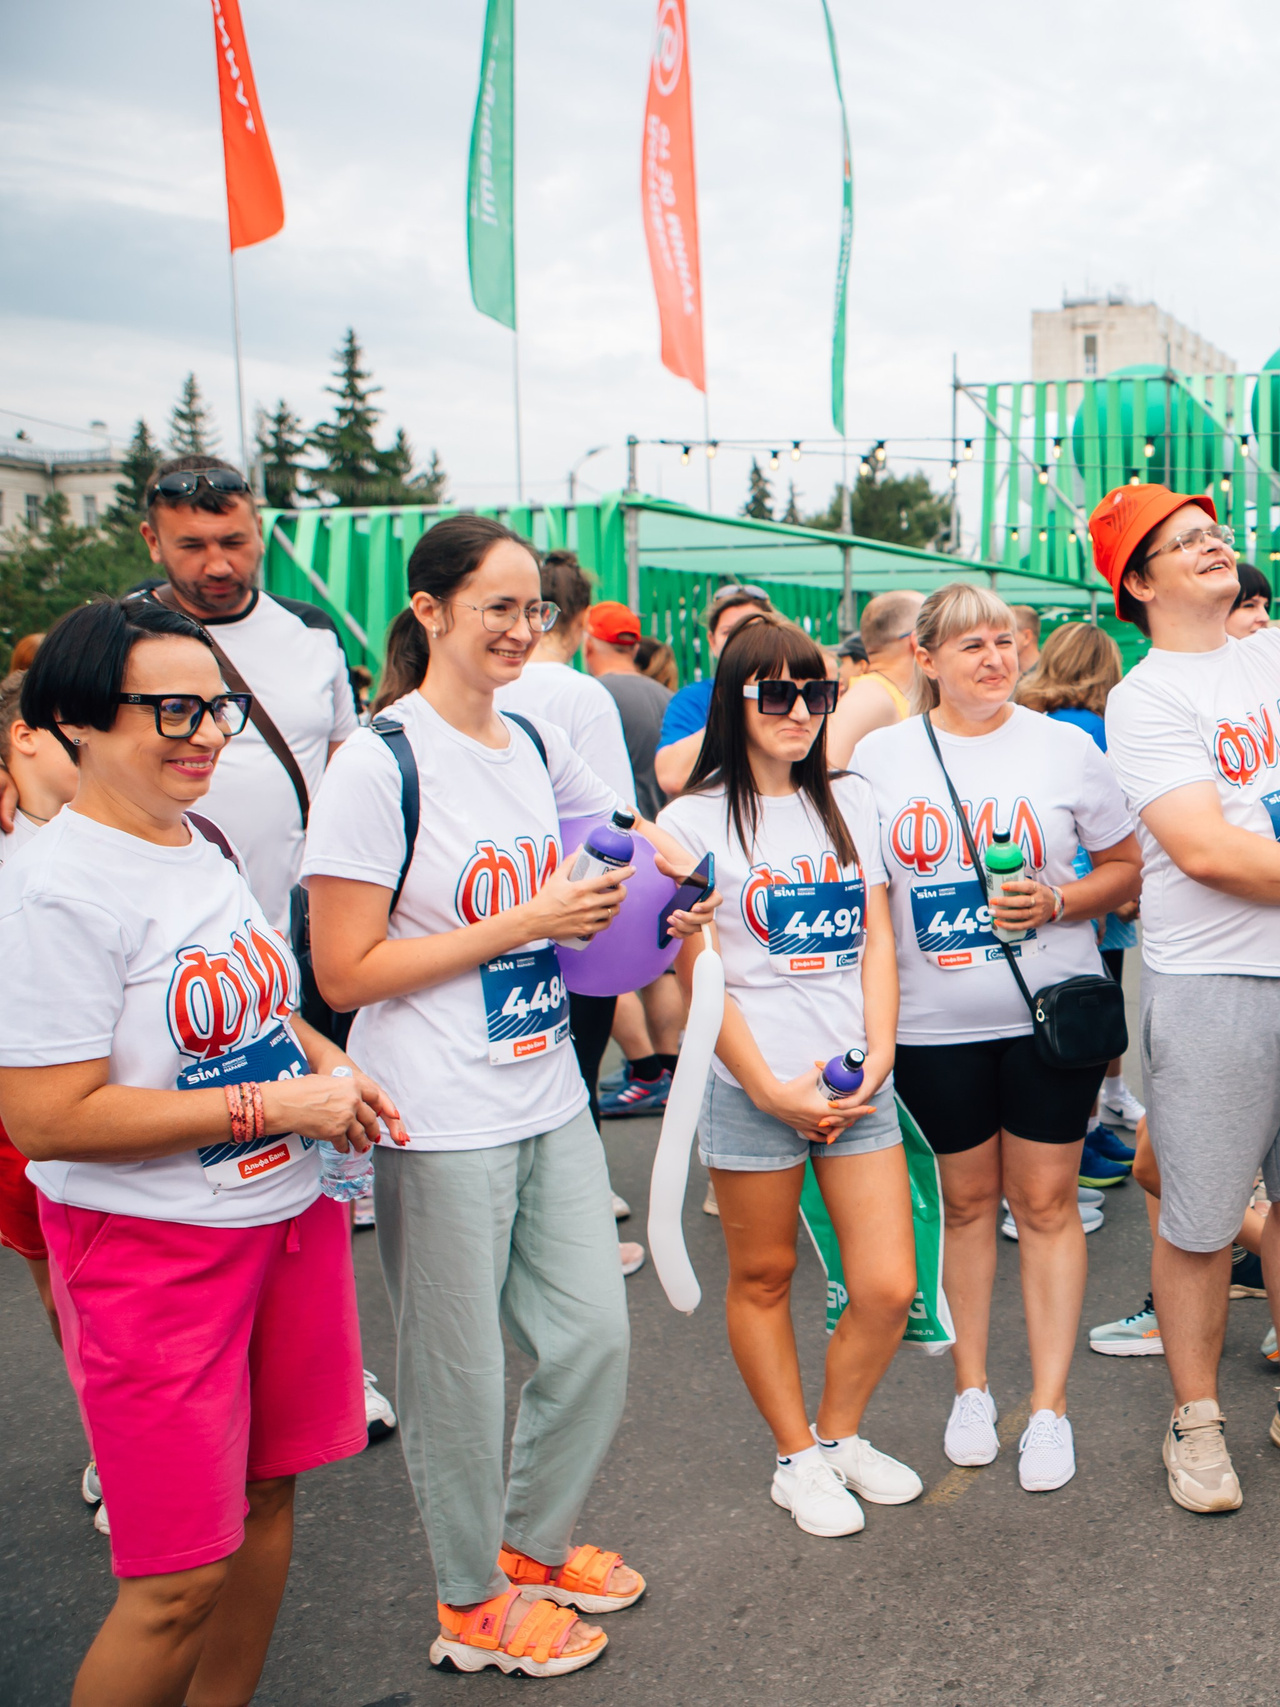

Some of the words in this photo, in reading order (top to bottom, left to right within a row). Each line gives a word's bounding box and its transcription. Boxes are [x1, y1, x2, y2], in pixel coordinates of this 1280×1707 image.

[455, 834, 564, 926] ФИ
[784, 906, 861, 939] 4492
[928, 905, 992, 937] 449
[244, 1157, 269, 1175] Альфа
[269, 1150, 286, 1163] Банк
